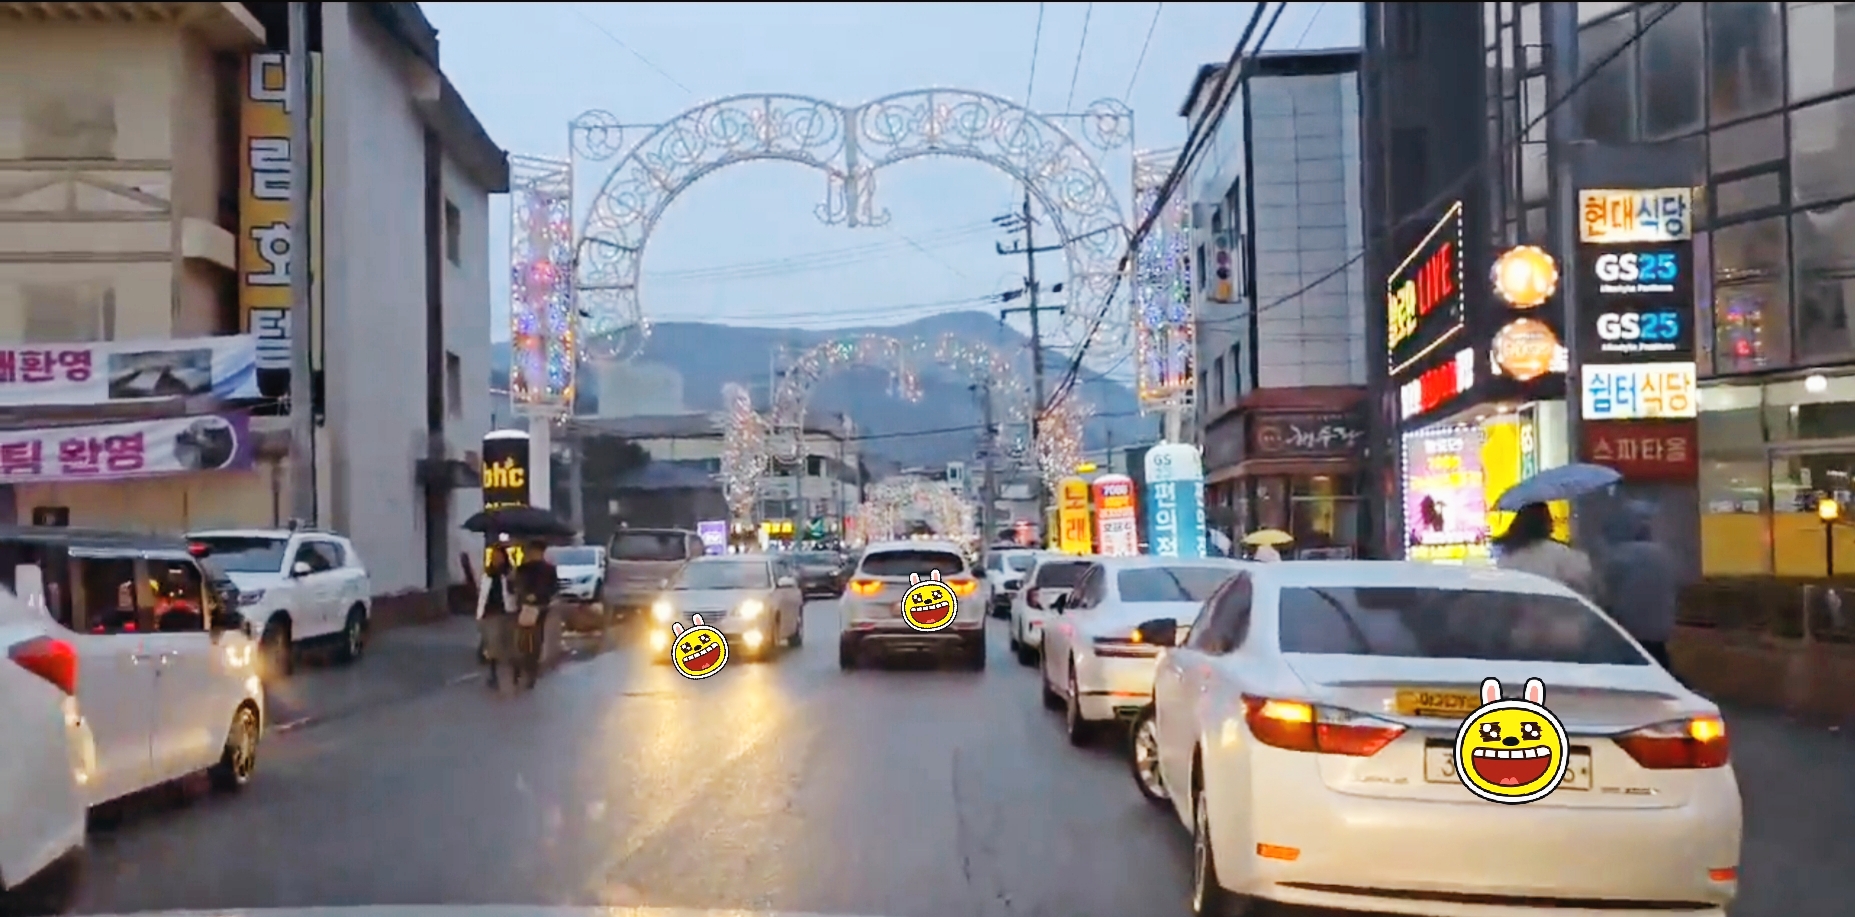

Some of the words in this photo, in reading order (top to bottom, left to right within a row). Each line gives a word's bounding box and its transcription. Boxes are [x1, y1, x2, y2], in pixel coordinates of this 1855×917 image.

[1585, 194, 1686, 236] 현대식당
[1418, 242, 1453, 316] LIVE
[1595, 252, 1678, 282] GS25
[1596, 311, 1679, 341] GS25
[1589, 372, 1691, 413] 쉼터식당
[58, 431, 145, 473] 환영
[483, 459, 525, 488] bhc
[1064, 486, 1086, 543] 노래
